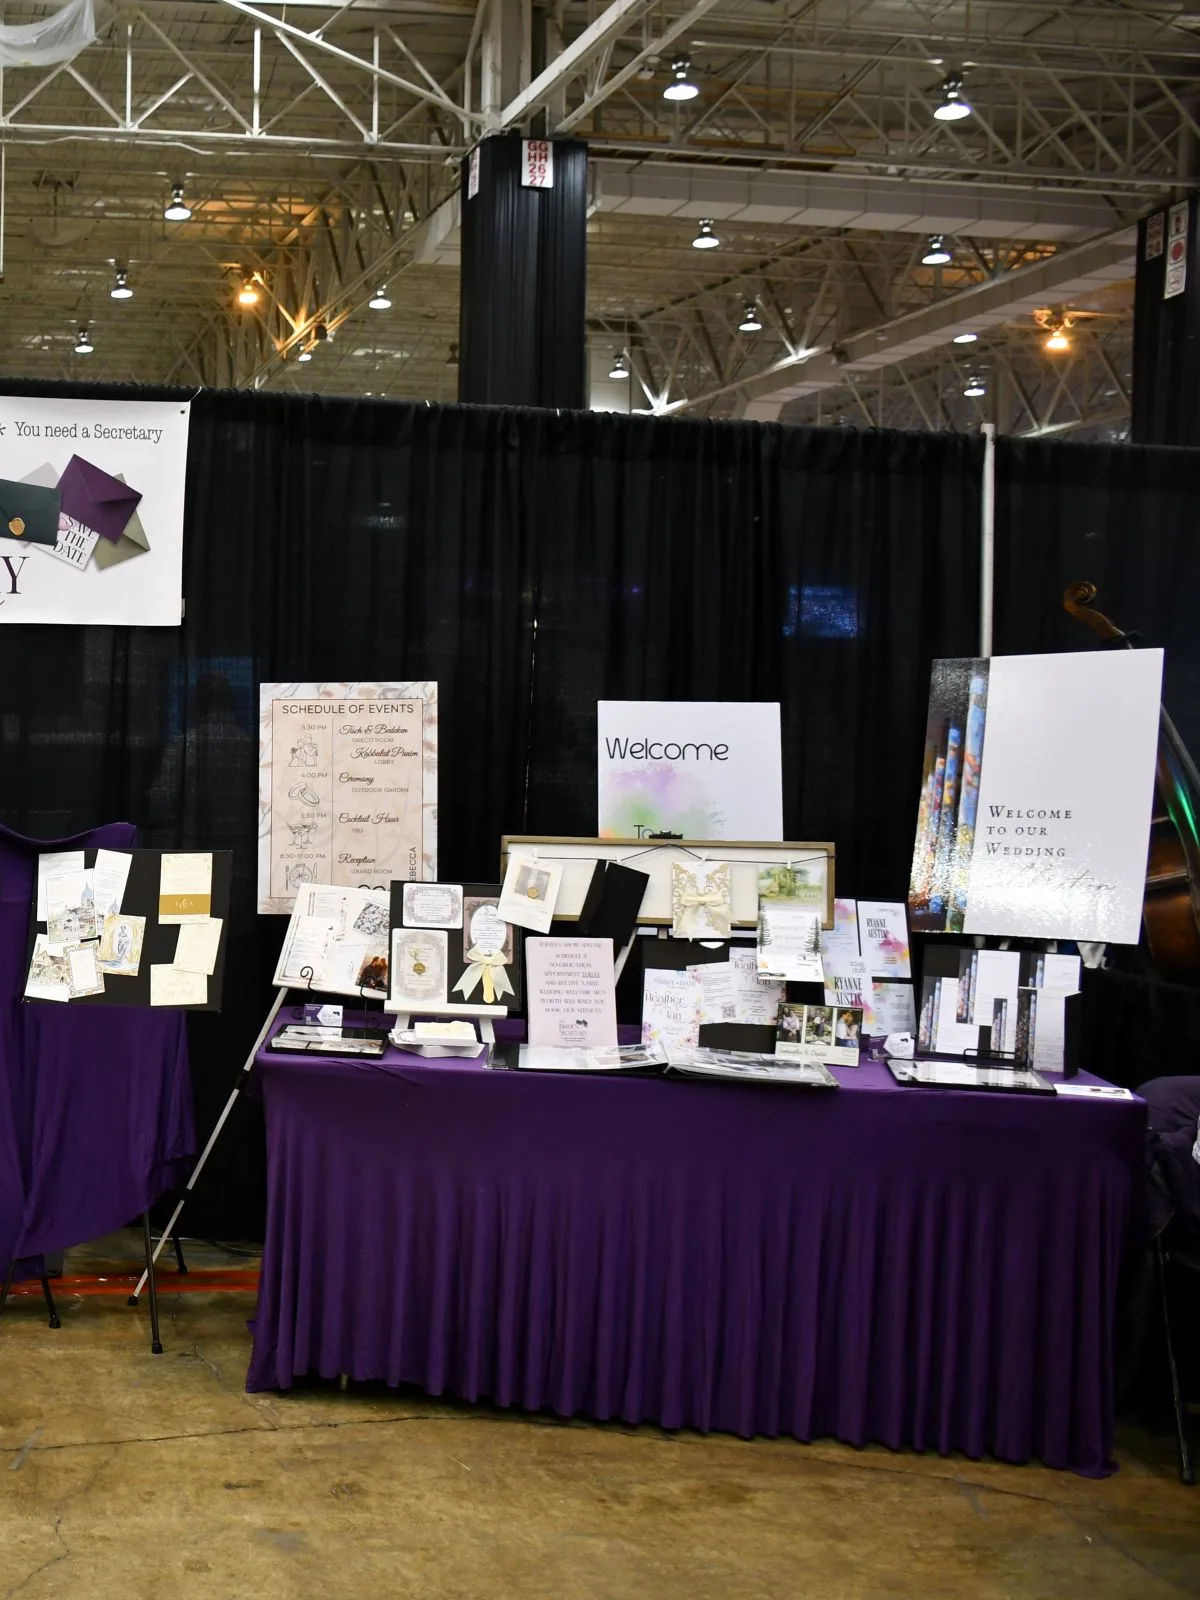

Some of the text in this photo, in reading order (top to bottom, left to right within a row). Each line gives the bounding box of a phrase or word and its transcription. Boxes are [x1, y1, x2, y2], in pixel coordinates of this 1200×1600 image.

[527, 141, 548, 152] GG
[527, 153, 548, 163] HH
[529, 163, 546, 174] 26
[15, 421, 41, 437] You
[44, 423, 78, 438] need
[81, 426, 91, 439] a
[94, 423, 163, 444] Secretary
[64, 530, 90, 549] THE
[52, 540, 88, 566] DATE
[282, 703, 414, 715] SCHEDULE OF EVENTS
[605, 737, 729, 761] Welcome
[338, 771, 375, 786] Ceremony
[338, 812, 371, 824] Cocktail
[988, 805, 1073, 820] WELCOME
[986, 825, 1049, 836] TO OUR
[338, 853, 377, 867] Reception
[408, 846, 417, 881] EBECCA
[834, 976, 863, 991] RYANNE
